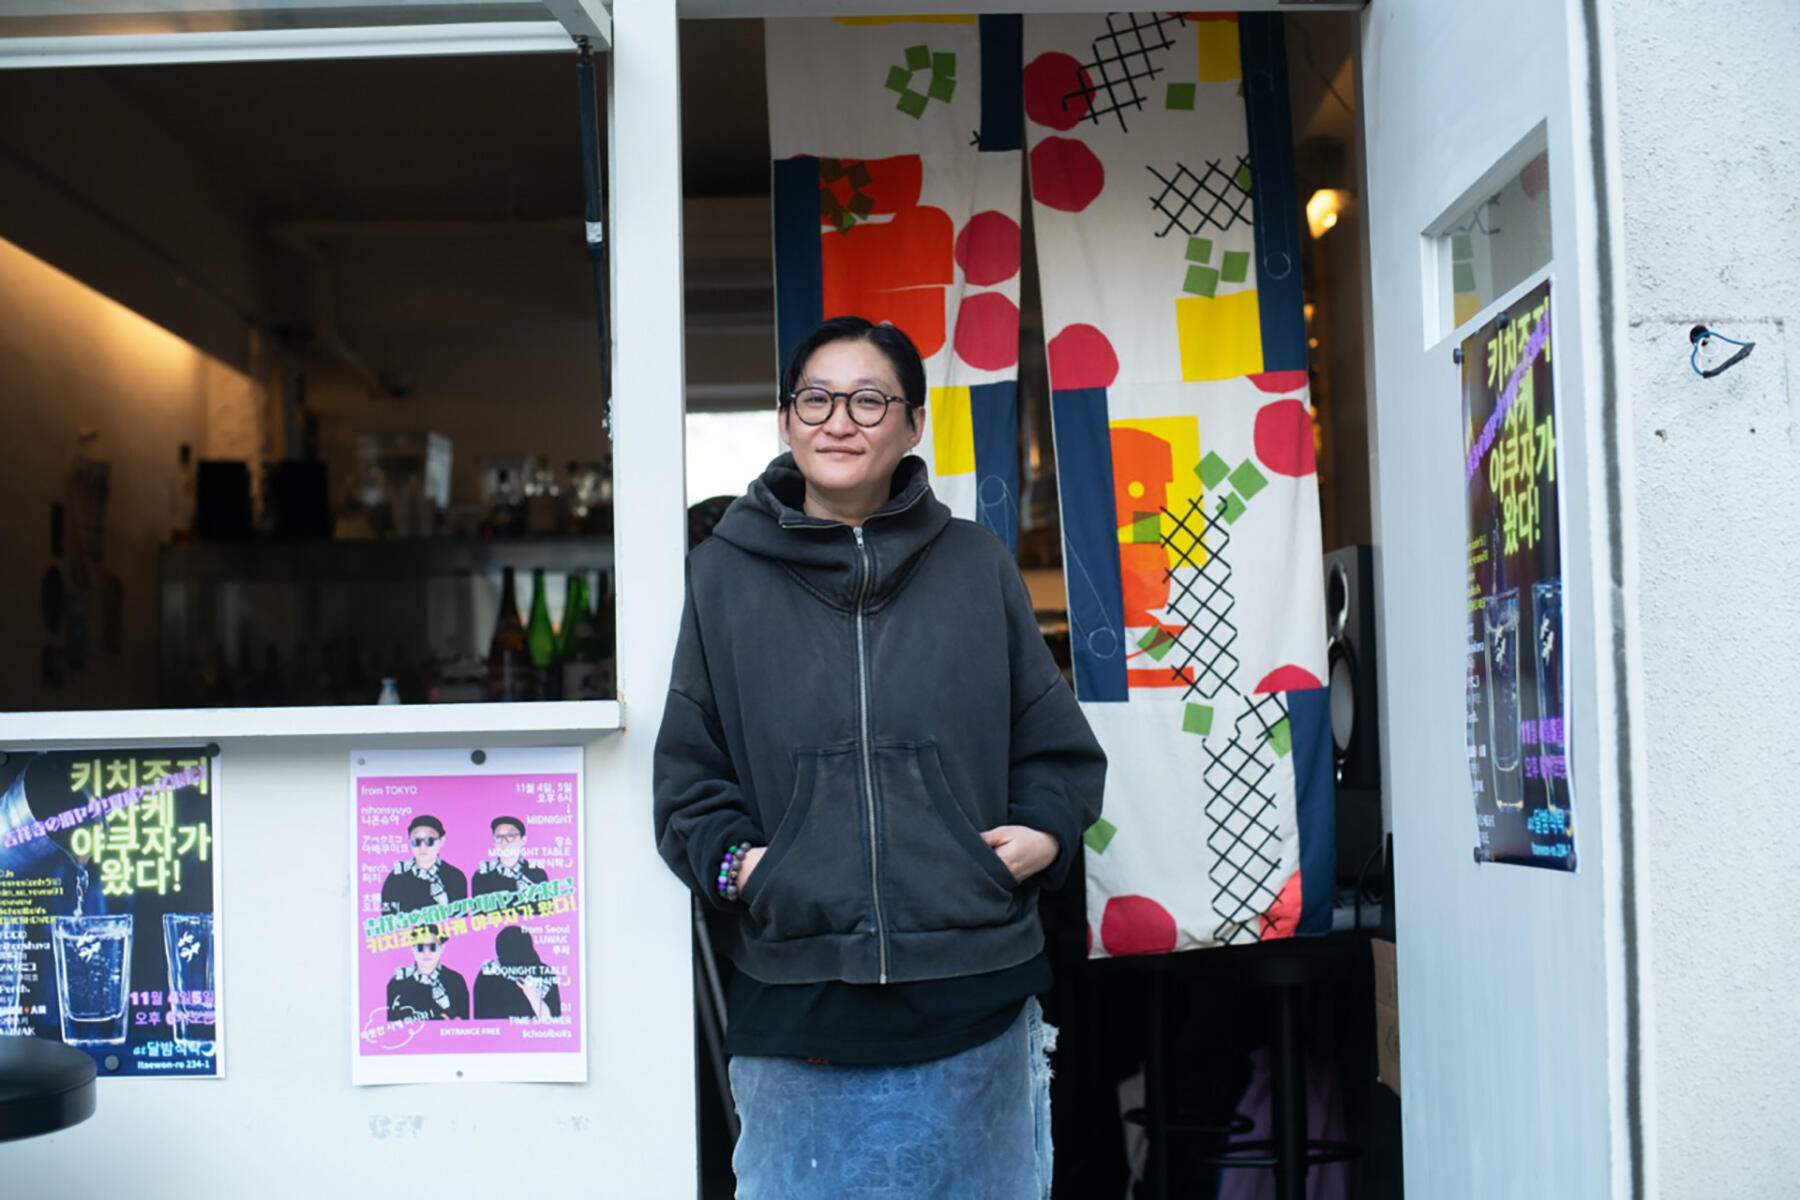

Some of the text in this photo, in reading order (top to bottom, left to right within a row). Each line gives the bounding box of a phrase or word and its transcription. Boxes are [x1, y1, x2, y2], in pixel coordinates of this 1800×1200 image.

[1489, 414, 1556, 503] 야쿠자가
[1503, 486, 1541, 556] 왔다!
[70, 756, 208, 796] 키치조지
[384, 785, 418, 796] TOKYO
[70, 822, 212, 864] 야쿠자가
[100, 857, 182, 896] 왔다!
[129, 990, 163, 1006] 11월
[135, 1011, 161, 1026] 오후
[440, 1027, 501, 1036] ENTRANCE FREE
